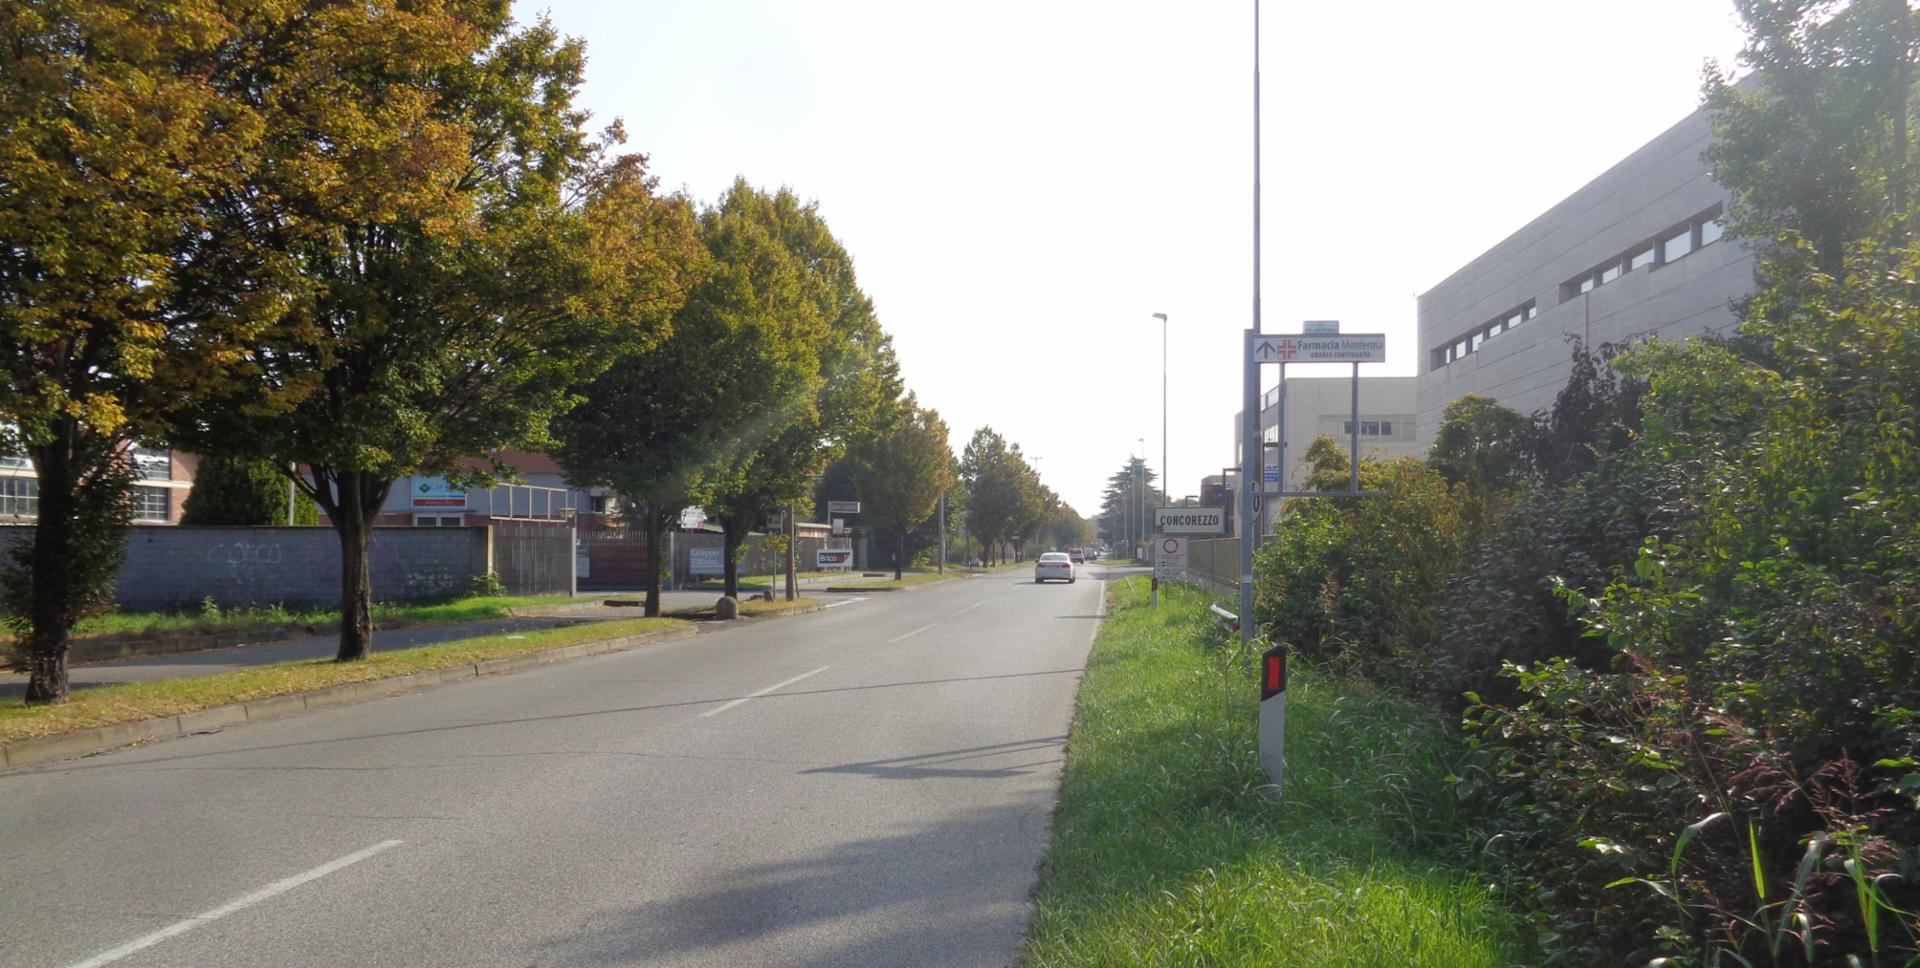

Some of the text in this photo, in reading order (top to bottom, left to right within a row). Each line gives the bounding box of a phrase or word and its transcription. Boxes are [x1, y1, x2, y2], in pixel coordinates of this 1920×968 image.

[1298, 340, 1383, 350] Farmacia Monterosa
[1160, 515, 1219, 526] CONCOREZZO
